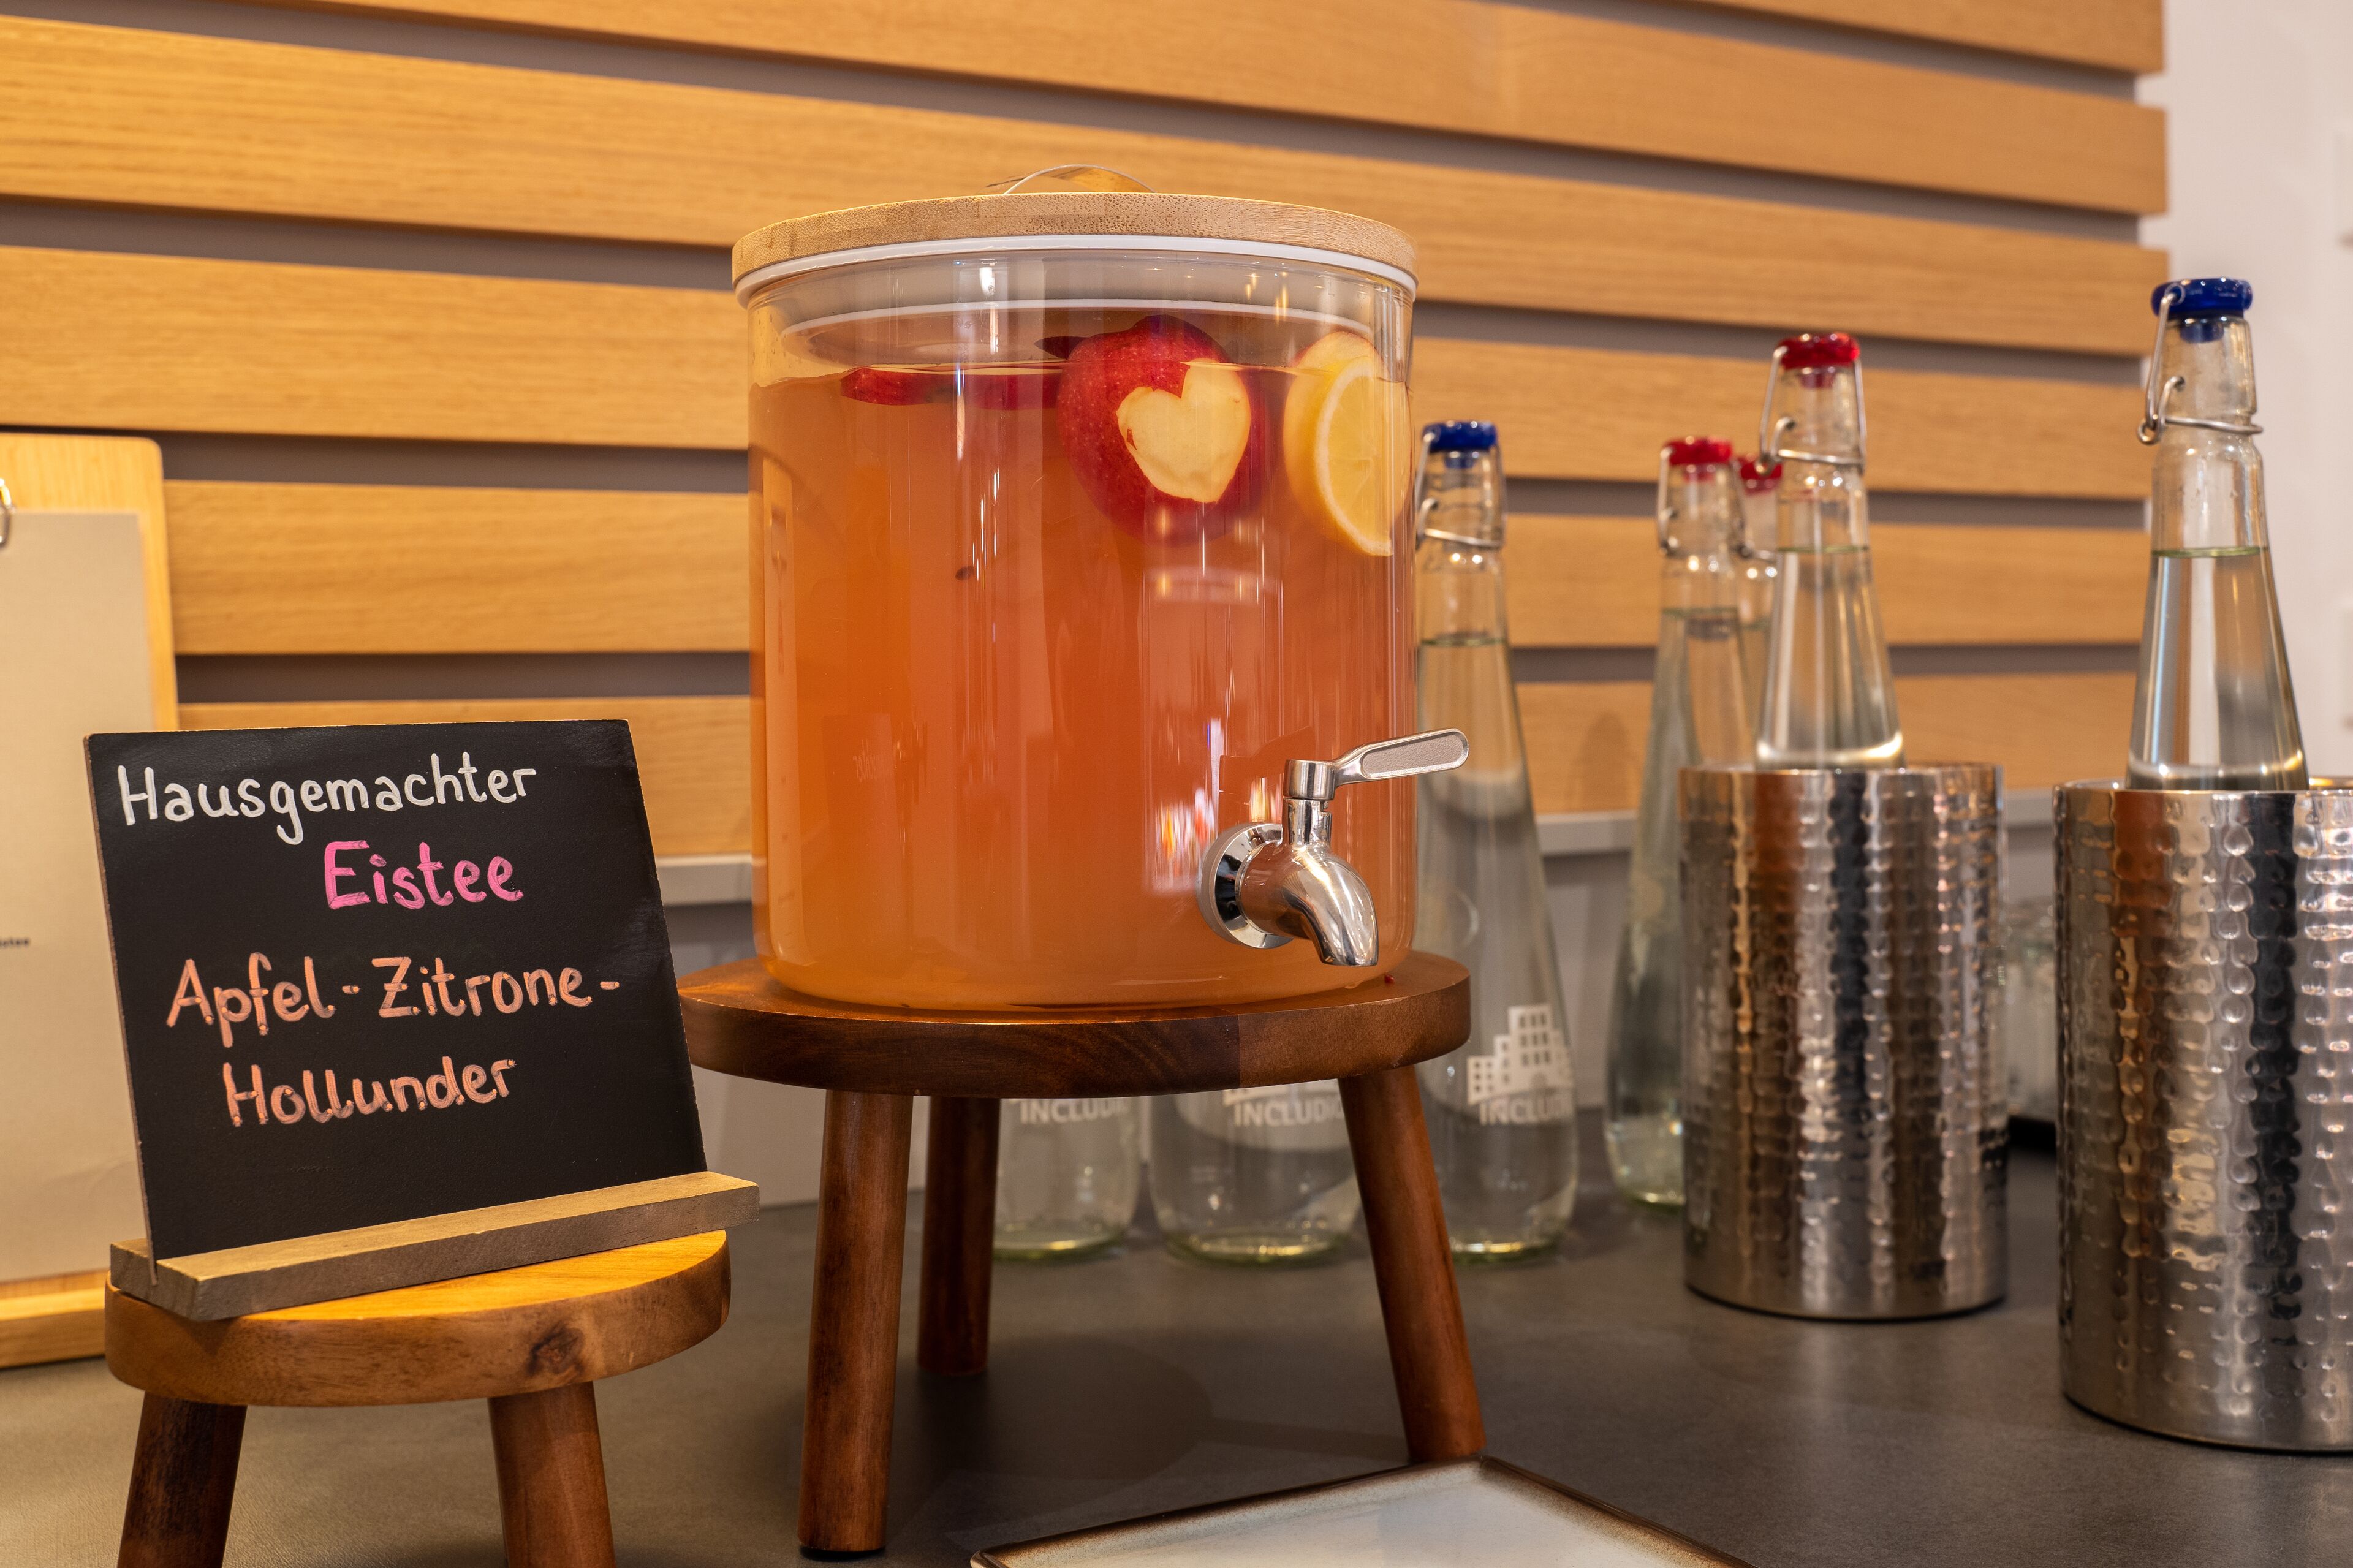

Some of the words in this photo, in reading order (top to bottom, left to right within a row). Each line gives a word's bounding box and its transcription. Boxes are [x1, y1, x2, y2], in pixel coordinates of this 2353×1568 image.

[117, 751, 537, 846] Hausgemachter
[324, 839, 524, 910] Eistee
[222, 1056, 517, 1127] Hollunder
